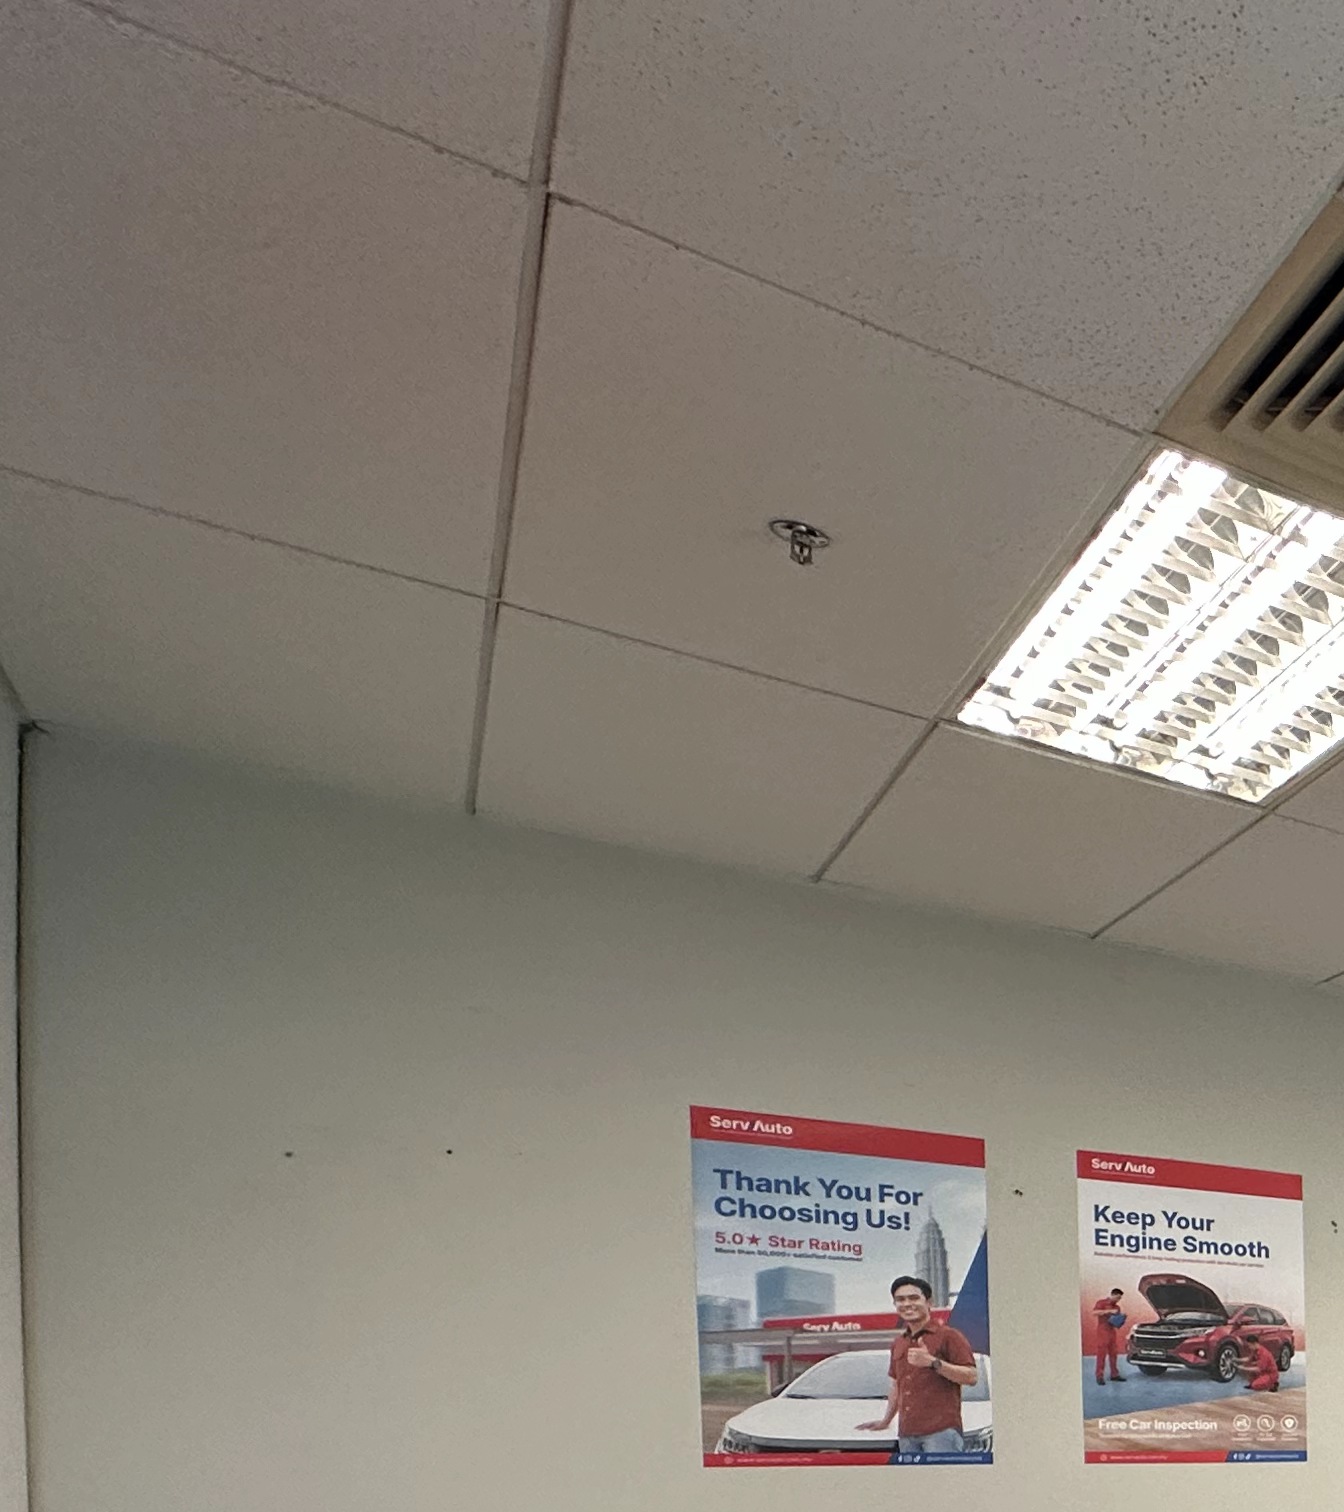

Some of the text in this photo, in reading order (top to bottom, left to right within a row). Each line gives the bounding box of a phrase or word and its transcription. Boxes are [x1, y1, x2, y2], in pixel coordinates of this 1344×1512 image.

[713, 1168, 923, 1207] Thank You For
[714, 1196, 910, 1231] Choosing Us!
[1094, 1204, 1215, 1231] Keep Your
[768, 1235, 804, 1250] Star
[808, 1238, 863, 1256] Rating
[1094, 1228, 1270, 1259] Engine Smooth
[1098, 1418, 1218, 1432] Free Car Inspection
